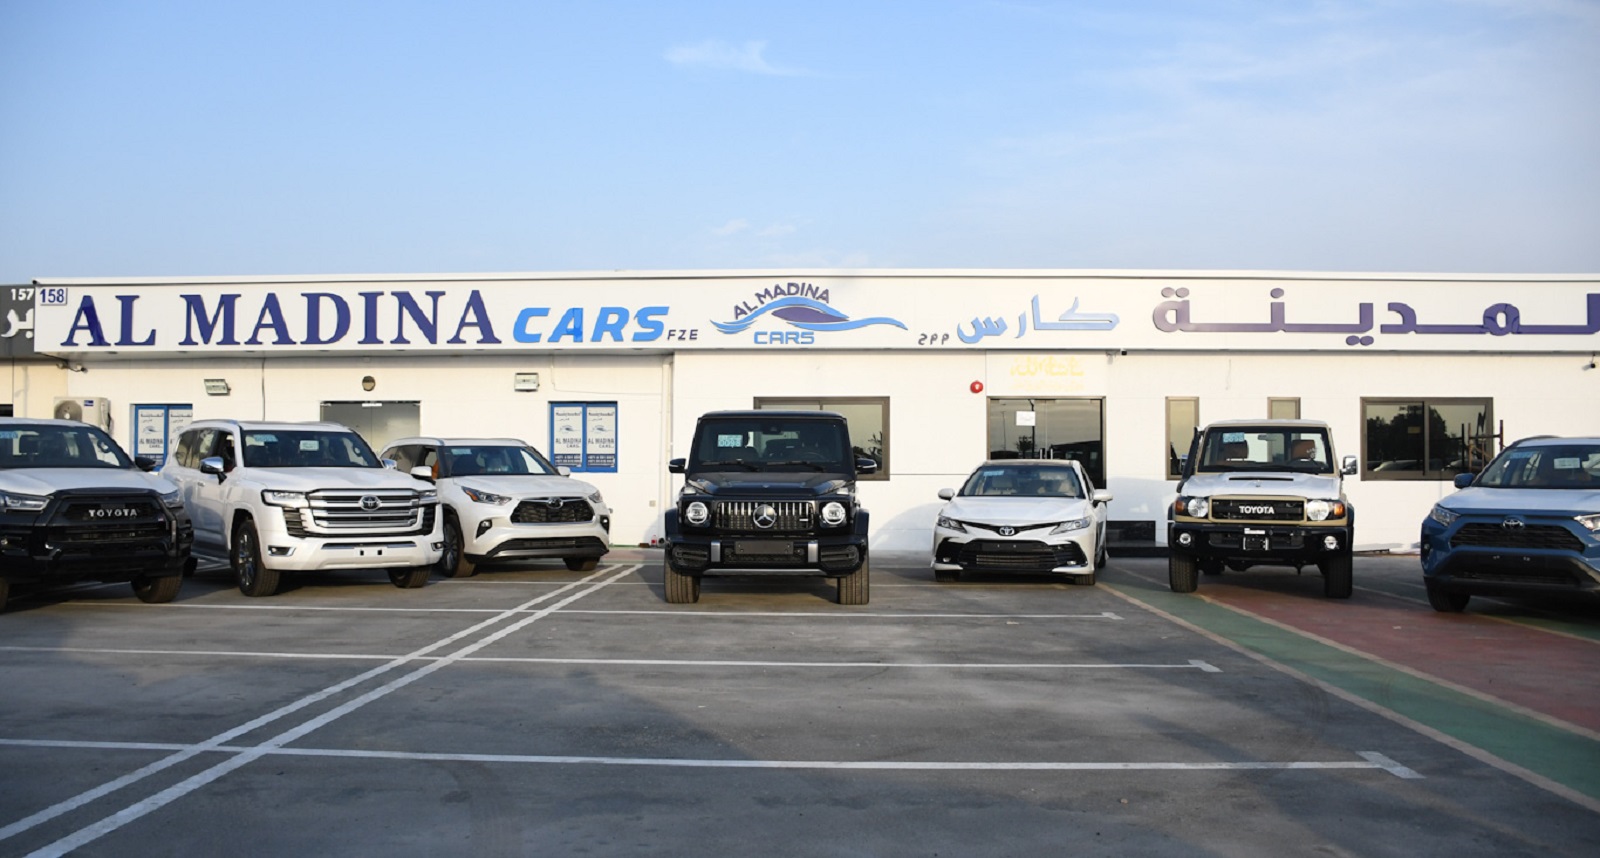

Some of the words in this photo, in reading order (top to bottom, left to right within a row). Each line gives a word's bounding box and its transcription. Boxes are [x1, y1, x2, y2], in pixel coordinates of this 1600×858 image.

[11, 288, 35, 301] 157
[40, 288, 65, 303] 158
[734, 301, 758, 320] AL
[755, 282, 829, 304] MADINA
[60, 294, 157, 346] AL
[178, 289, 502, 345] MADINA
[512, 306, 670, 343] CARS
[667, 329, 699, 341] FZE
[956, 295, 1120, 344] كارس
[1152, 287, 1600, 347] لمدينة
[753, 331, 815, 345] CARS
[88, 508, 138, 518] TOYOTA
[1238, 505, 1275, 514] TOYOTA
